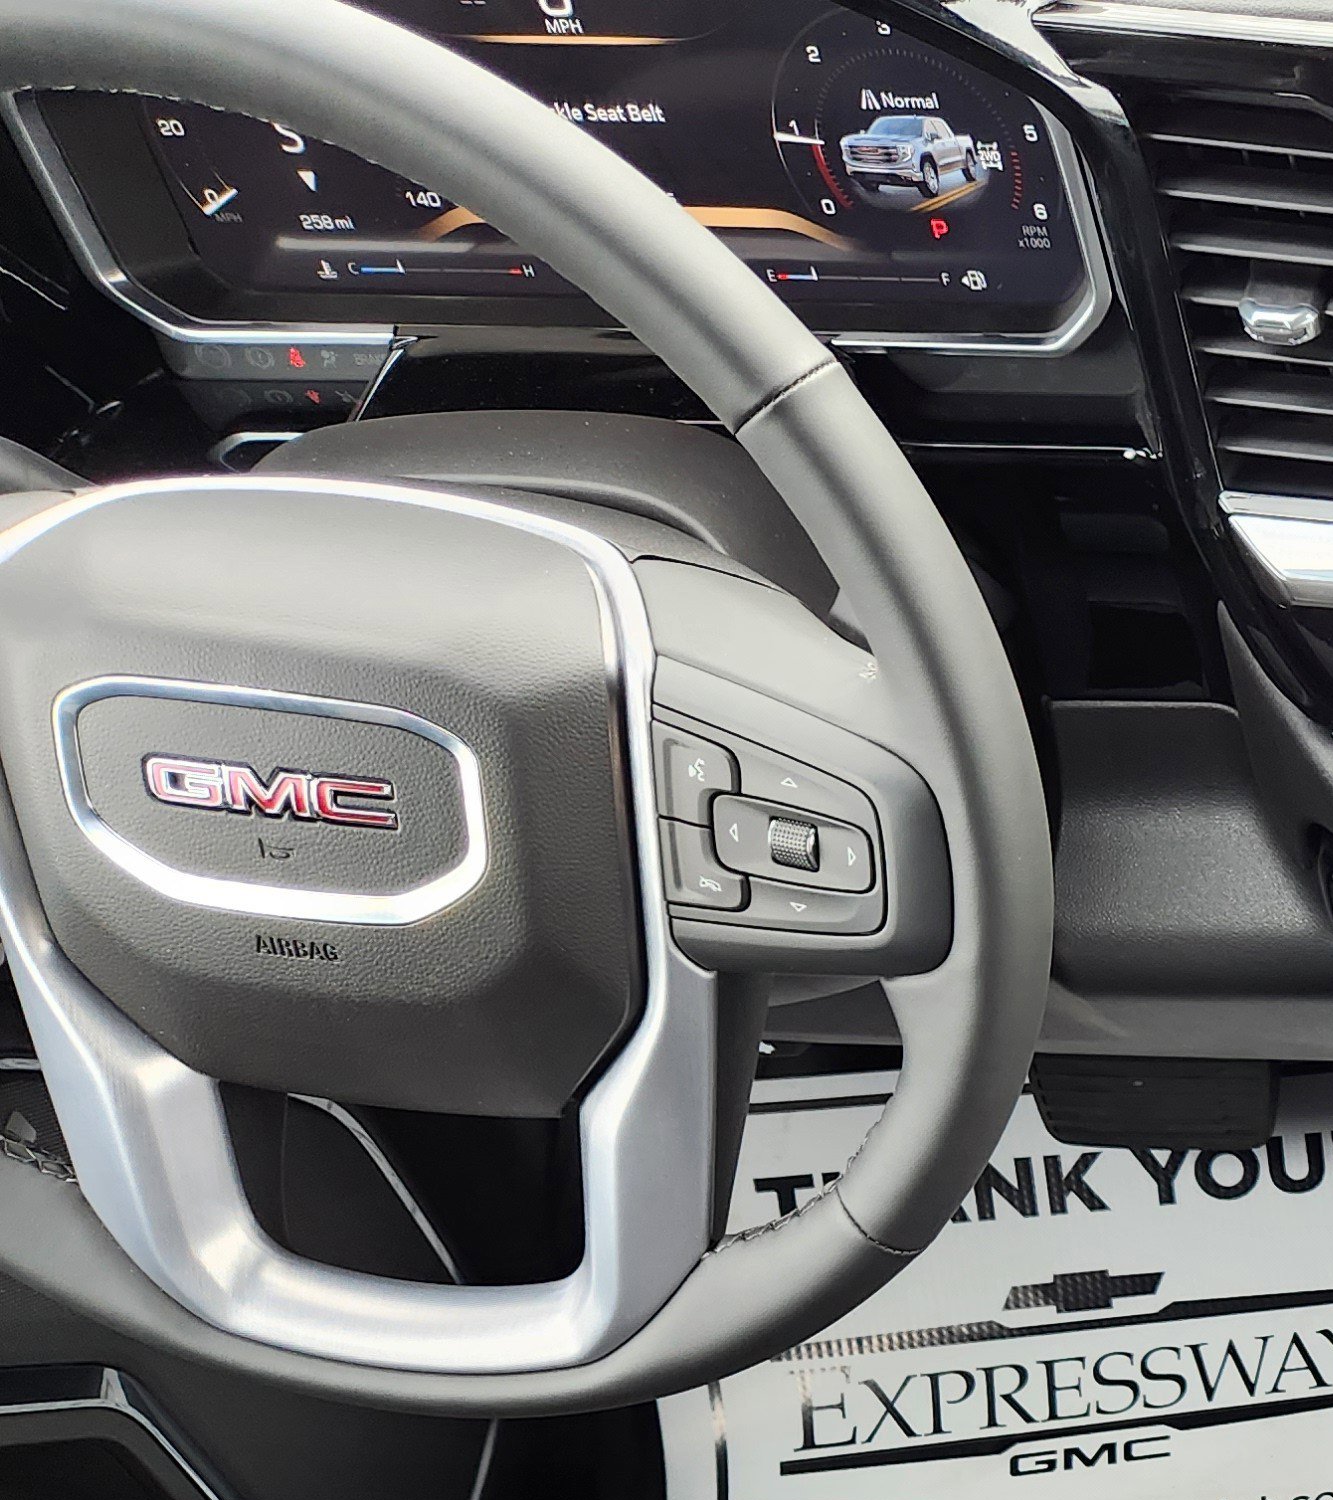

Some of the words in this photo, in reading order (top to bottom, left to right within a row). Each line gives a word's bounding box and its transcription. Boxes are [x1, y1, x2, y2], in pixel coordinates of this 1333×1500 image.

[545, 18, 584, 34] MPH
[806, 45, 821, 63] 2
[881, 92, 939, 110] Normal
[584, 103, 628, 122] Seat
[626, 104, 666, 123] Belt
[157, 119, 185, 136] 20
[1023, 124, 1038, 142] 5
[405, 191, 441, 208] 140
[821, 199, 836, 215] 0
[1034, 203, 1048, 220] 6
[299, 214, 334, 231] 258
[334, 216, 355, 230] mi
[930, 219, 948, 238] P
[1022, 226, 1048, 236] RPM
[141, 752, 400, 830] GMC
[256, 934, 339, 962] AIRBAG
[753, 1151, 1111, 1223] TNK
[1009, 1435, 1171, 1477] GMC
